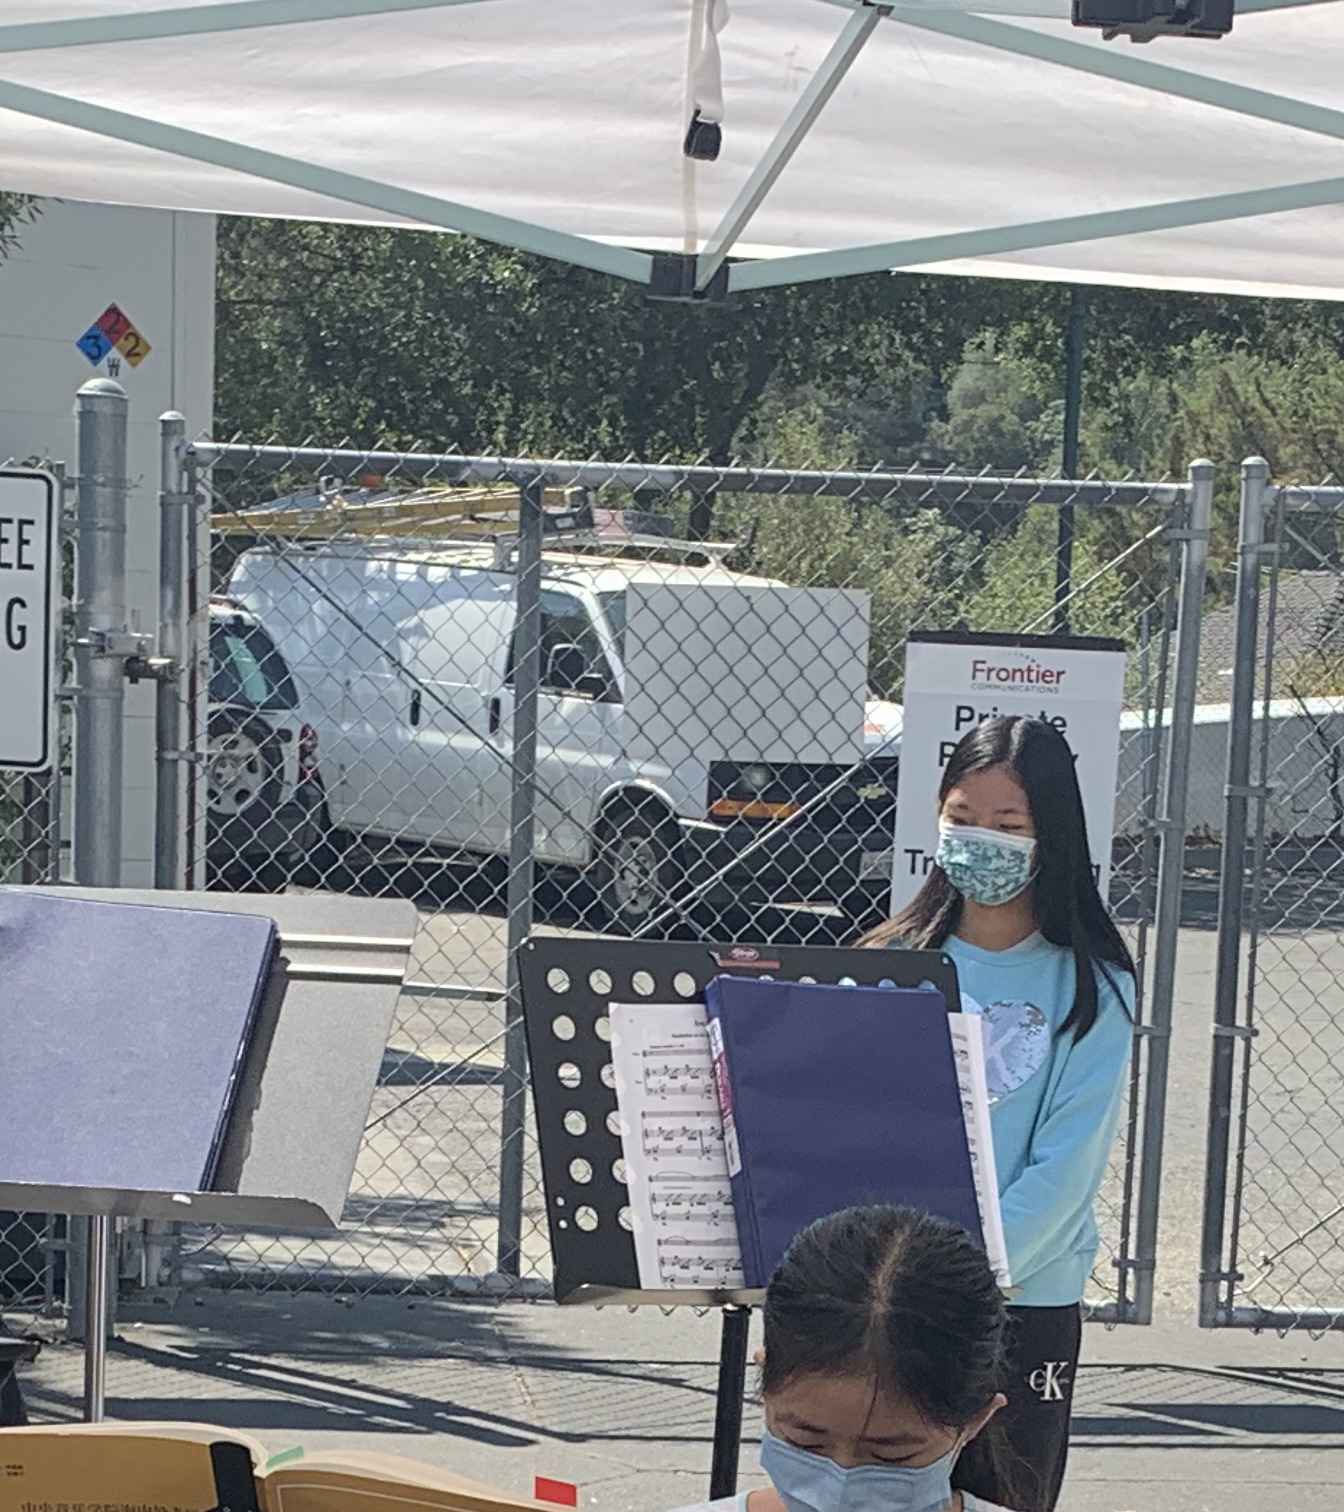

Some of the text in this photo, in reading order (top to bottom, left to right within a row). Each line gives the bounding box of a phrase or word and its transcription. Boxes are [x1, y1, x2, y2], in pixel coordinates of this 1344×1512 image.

[105, 306, 123, 335] 2
[84, 332, 141, 359] 3 2
[971, 660, 1066, 685] Frontier
[970, 682, 1060, 695] COMMUNICATIONS
[955, 705, 1068, 734] Prite
